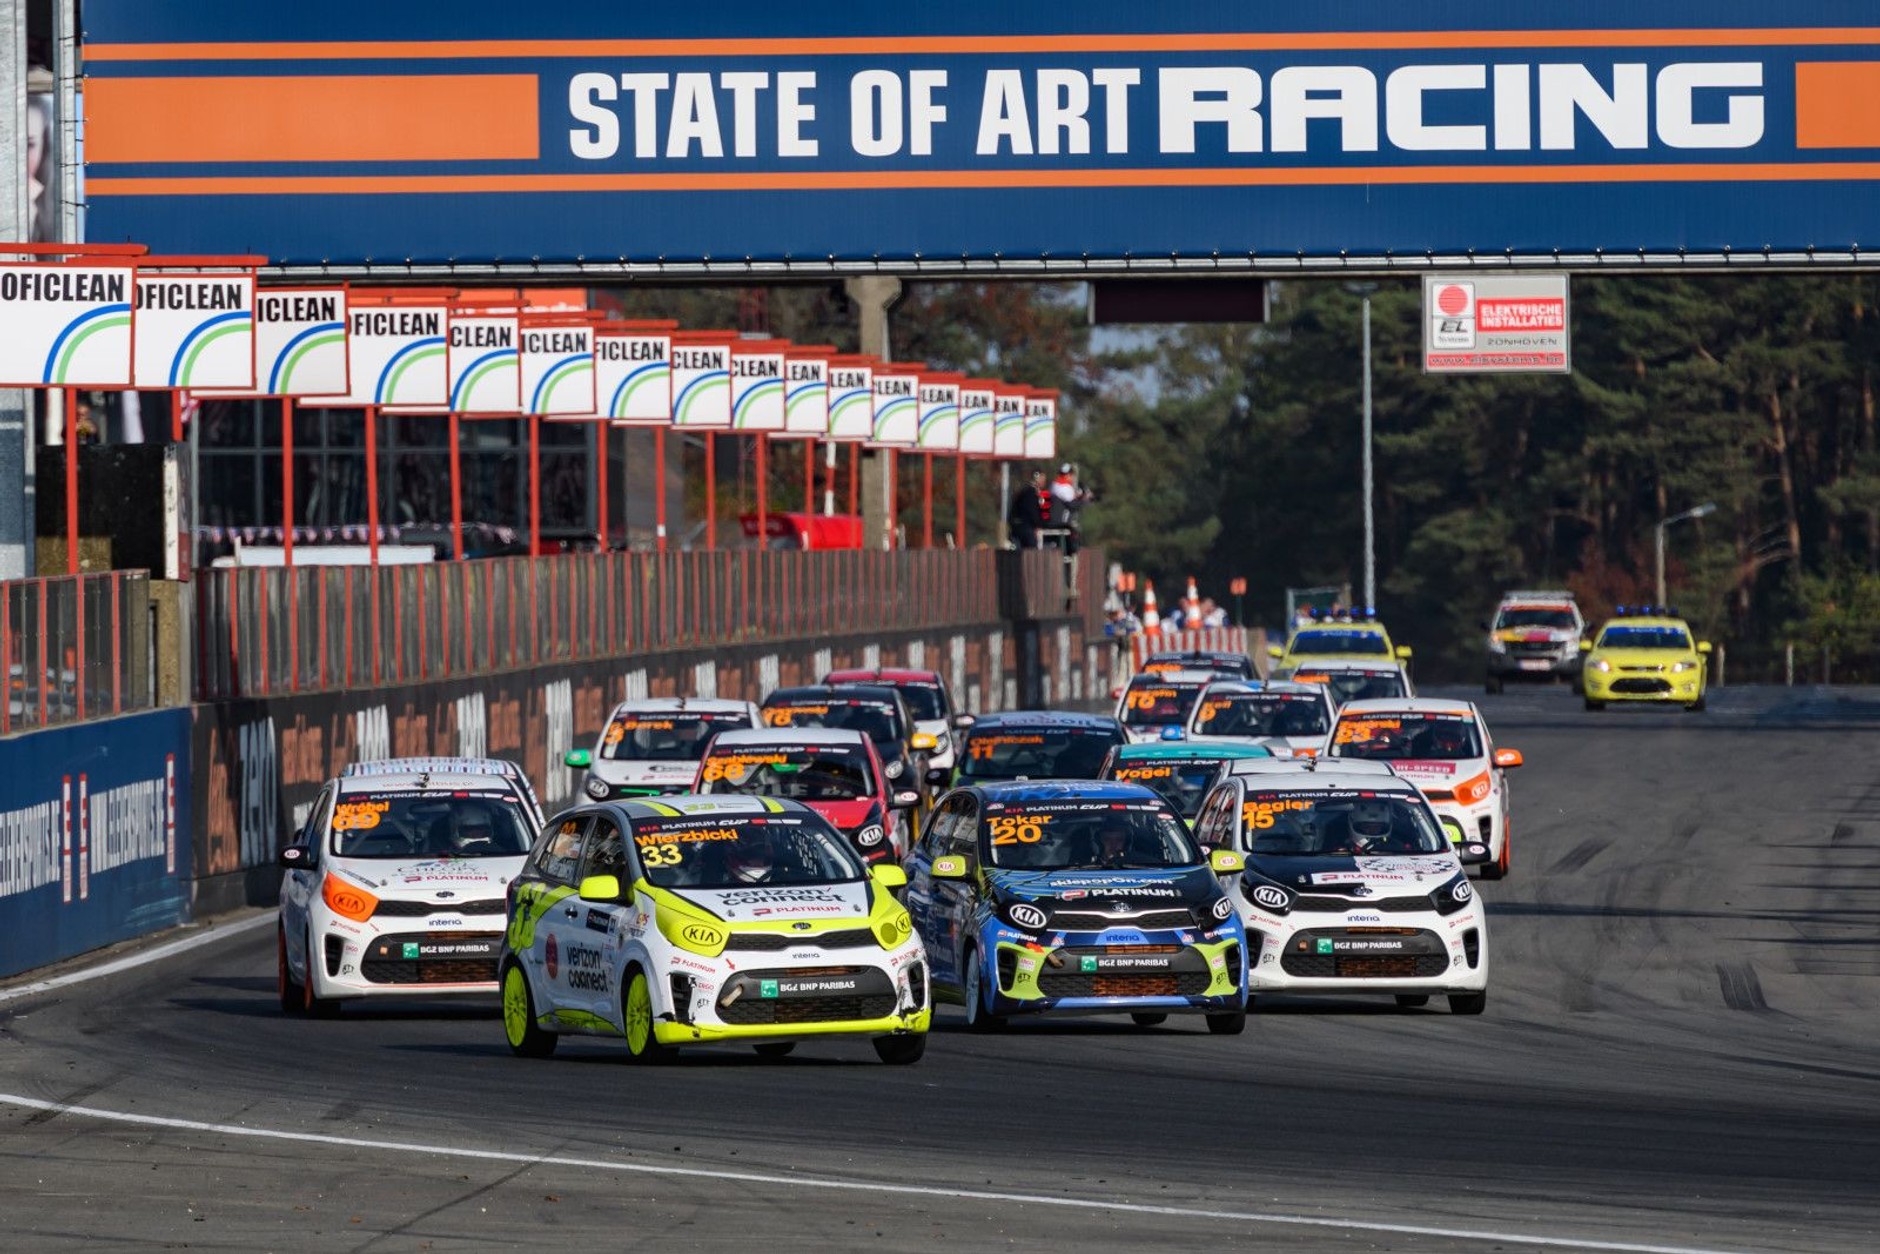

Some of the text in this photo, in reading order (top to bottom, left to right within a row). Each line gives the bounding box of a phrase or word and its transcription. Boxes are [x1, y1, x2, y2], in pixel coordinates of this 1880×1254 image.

[569, 62, 1765, 159] STATE OF ART RACING
[1, 273, 124, 302] OFICLEAN
[1481, 304, 1562, 316] ELEKTRISCHE
[350, 312, 439, 336] FICLEAN
[1482, 315, 1562, 327] INSTALLATIES
[1488, 338, 1557, 346] ZONHOVEN
[1115, 767, 1172, 780] Vogel
[370, 792, 420, 800] PLATINUM
[1279, 791, 1328, 799] PLATINUM
[1026, 804, 1078, 812] PLATINUM
[1080, 803, 1109, 811] CUP
[662, 819, 717, 830] PLATINUM
[718, 818, 749, 827] CUP
[987, 814, 1053, 828] Tokar
[1242, 809, 1275, 829] 15
[635, 828, 739, 848] Wierzbicki
[863, 827, 882, 843] KIA
[992, 823, 1043, 846] 20
[641, 843, 683, 867] 33
[1342, 873, 1404, 881] PLATINUM
[715, 886, 825, 900] verizon
[1091, 888, 1175, 897] PLATINUM
[1257, 888, 1281, 904] KIA
[338, 897, 359, 910] KIA
[722, 893, 848, 906] connect
[775, 905, 842, 914] PLATINUM
[1015, 911, 1041, 927] KIA
[689, 929, 715, 943] KIA
[1105, 934, 1140, 942] interia
[438, 945, 454, 953] BNP
[455, 944, 490, 953] PARIBAS
[1369, 941, 1402, 949] PARIBAS
[566, 942, 601, 969] verizon
[1135, 958, 1168, 966] PARIBAS
[682, 959, 716, 974] PLATINUM
[568, 970, 609, 993] connect
[800, 982, 817, 991] BNP
[819, 980, 855, 989] PARIBAS
